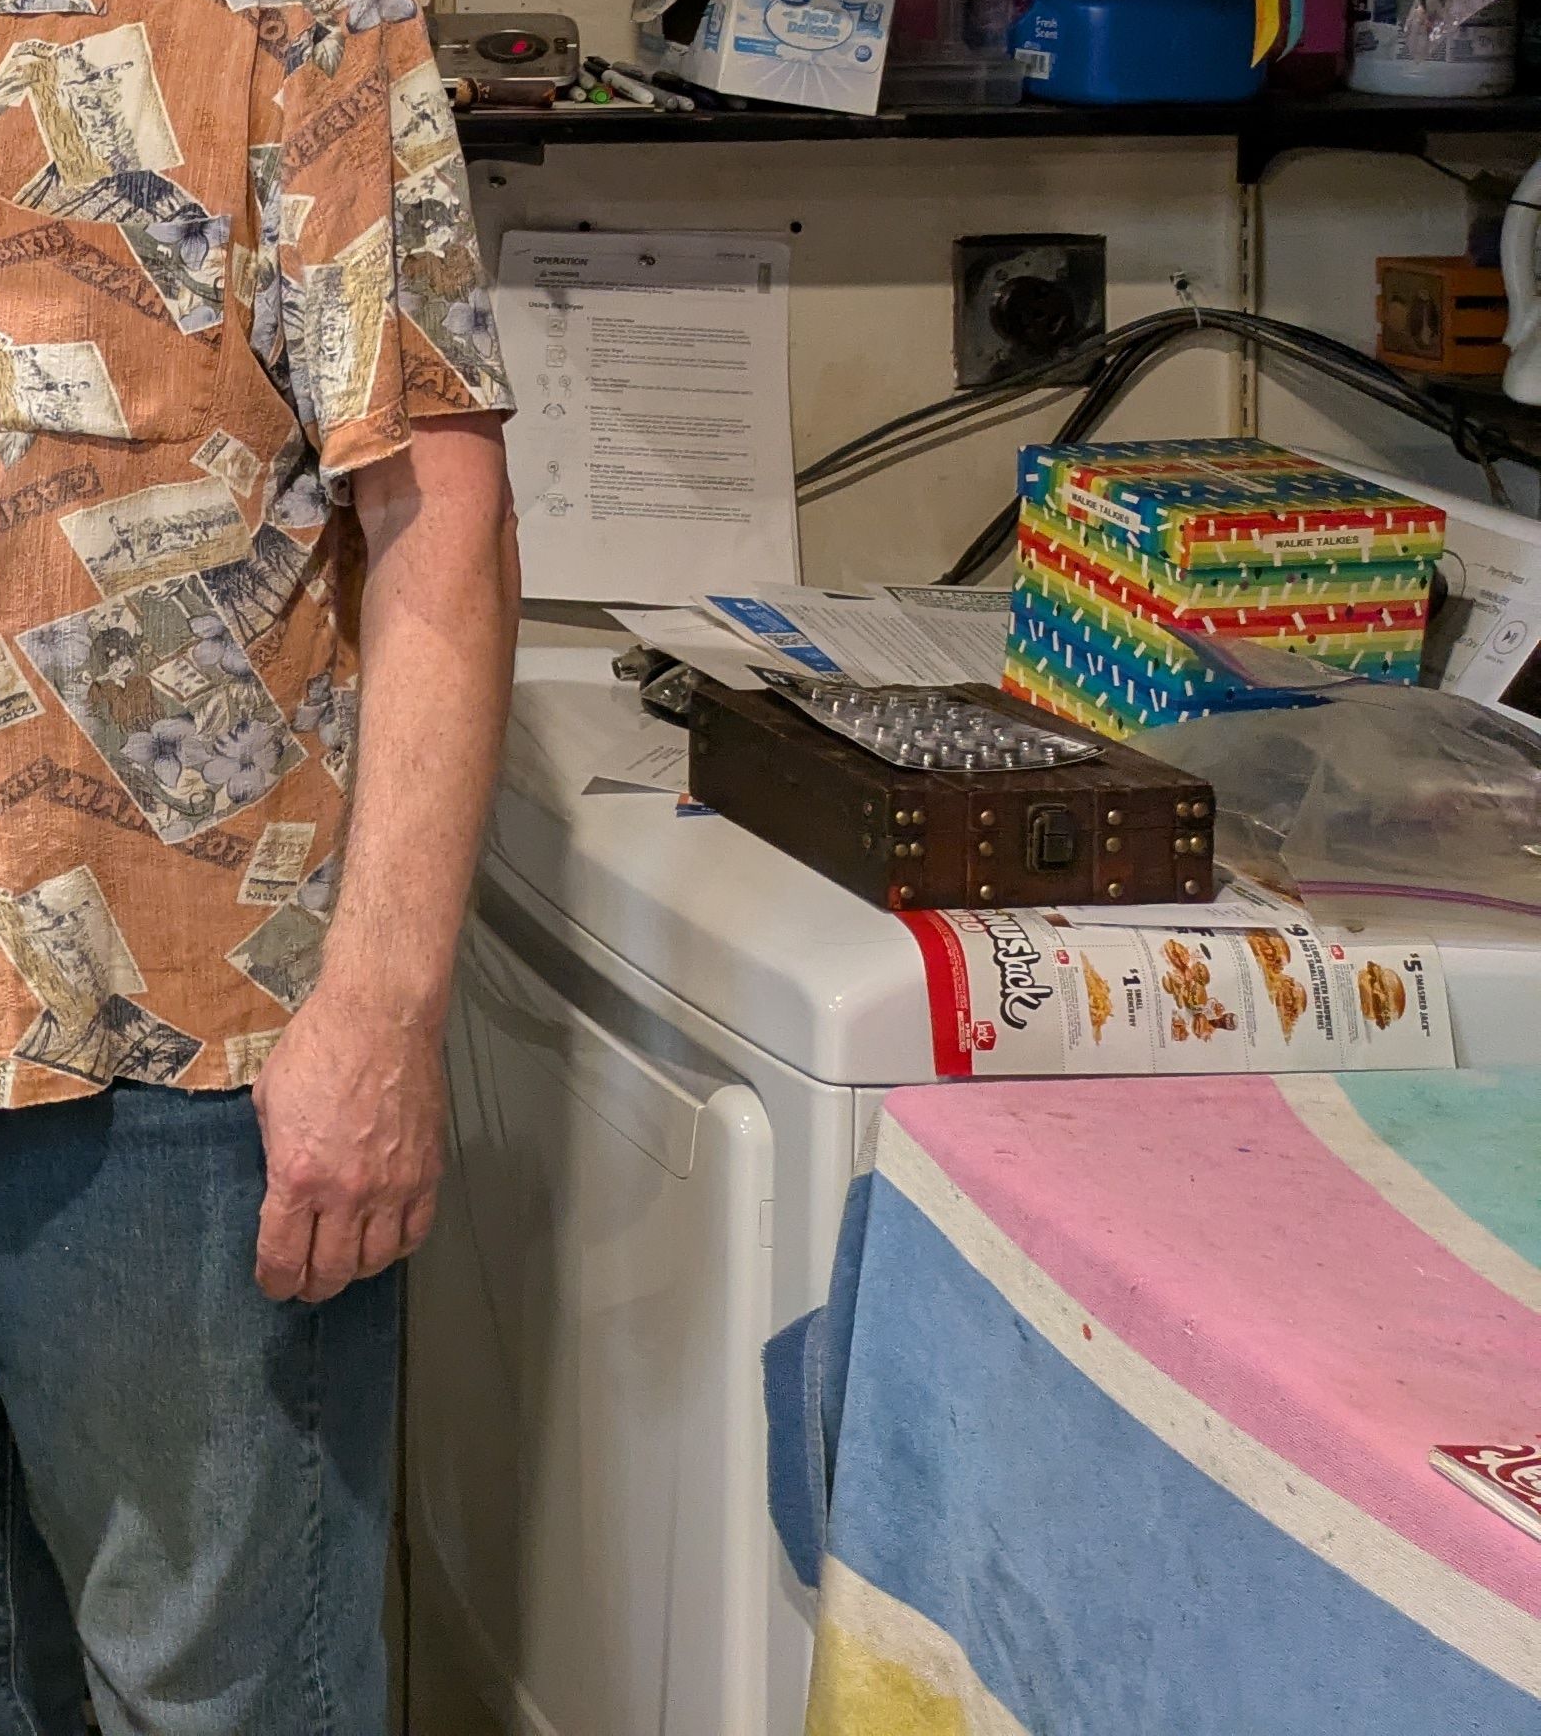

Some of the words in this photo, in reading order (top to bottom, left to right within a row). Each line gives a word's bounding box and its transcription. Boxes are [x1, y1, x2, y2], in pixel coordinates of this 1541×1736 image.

[1036, 16, 1058, 28] Fresh
[1035, 27, 1058, 40] Scent
[533, 256, 589, 266] OPERATION
[529, 301, 549, 309] Using
[565, 303, 584, 311] Dryer
[1071, 492, 1098, 511] WALKIE
[1099, 504, 1130, 525] TALKIES
[1275, 538, 1314, 549] WALKIE
[1318, 535, 1359, 546] TALKIES
[1307, 959, 1317, 981] SMALL
[1403, 953, 1423, 972] $5
[1122, 968, 1141, 986] $1
[1126, 989, 1136, 1014] FRENCH
[1135, 989, 1143, 1009] SMALL
[1312, 982, 1322, 1009] FRENCH
[1316, 965, 1328, 995] CHICKEN
[1322, 996, 1334, 1040] SANDWICHES
[1415, 975, 1427, 1011] SMASHED
[1316, 1010, 1325, 1030] FRIES
